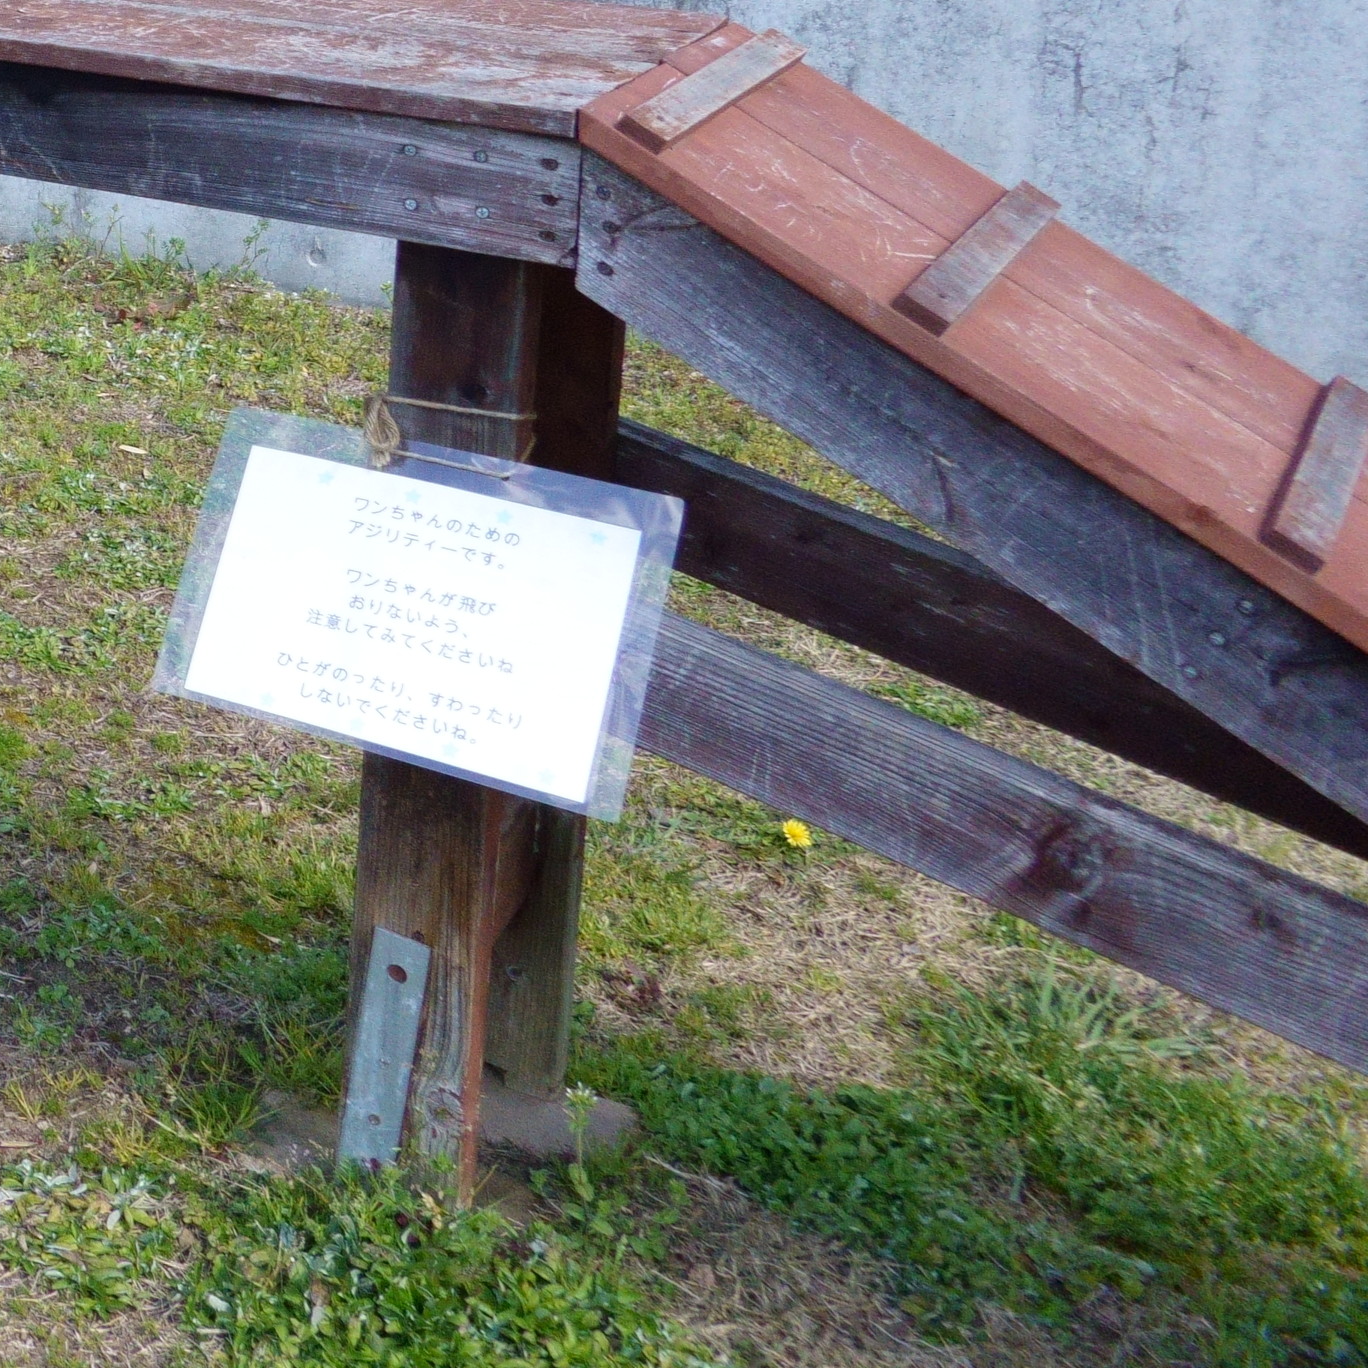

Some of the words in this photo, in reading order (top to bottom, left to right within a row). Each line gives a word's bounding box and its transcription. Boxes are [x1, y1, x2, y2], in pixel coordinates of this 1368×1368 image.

[347, 518, 505, 570] アジリティーです。
[354, 496, 521, 547] ワンちゃんのための
[346, 568, 497, 616] ワンちゃんが飛び
[349, 594, 469, 639] おりないよう、
[305, 607, 514, 674] 注意してみてくださいね
[299, 682, 477, 744] しないでくださいね。
